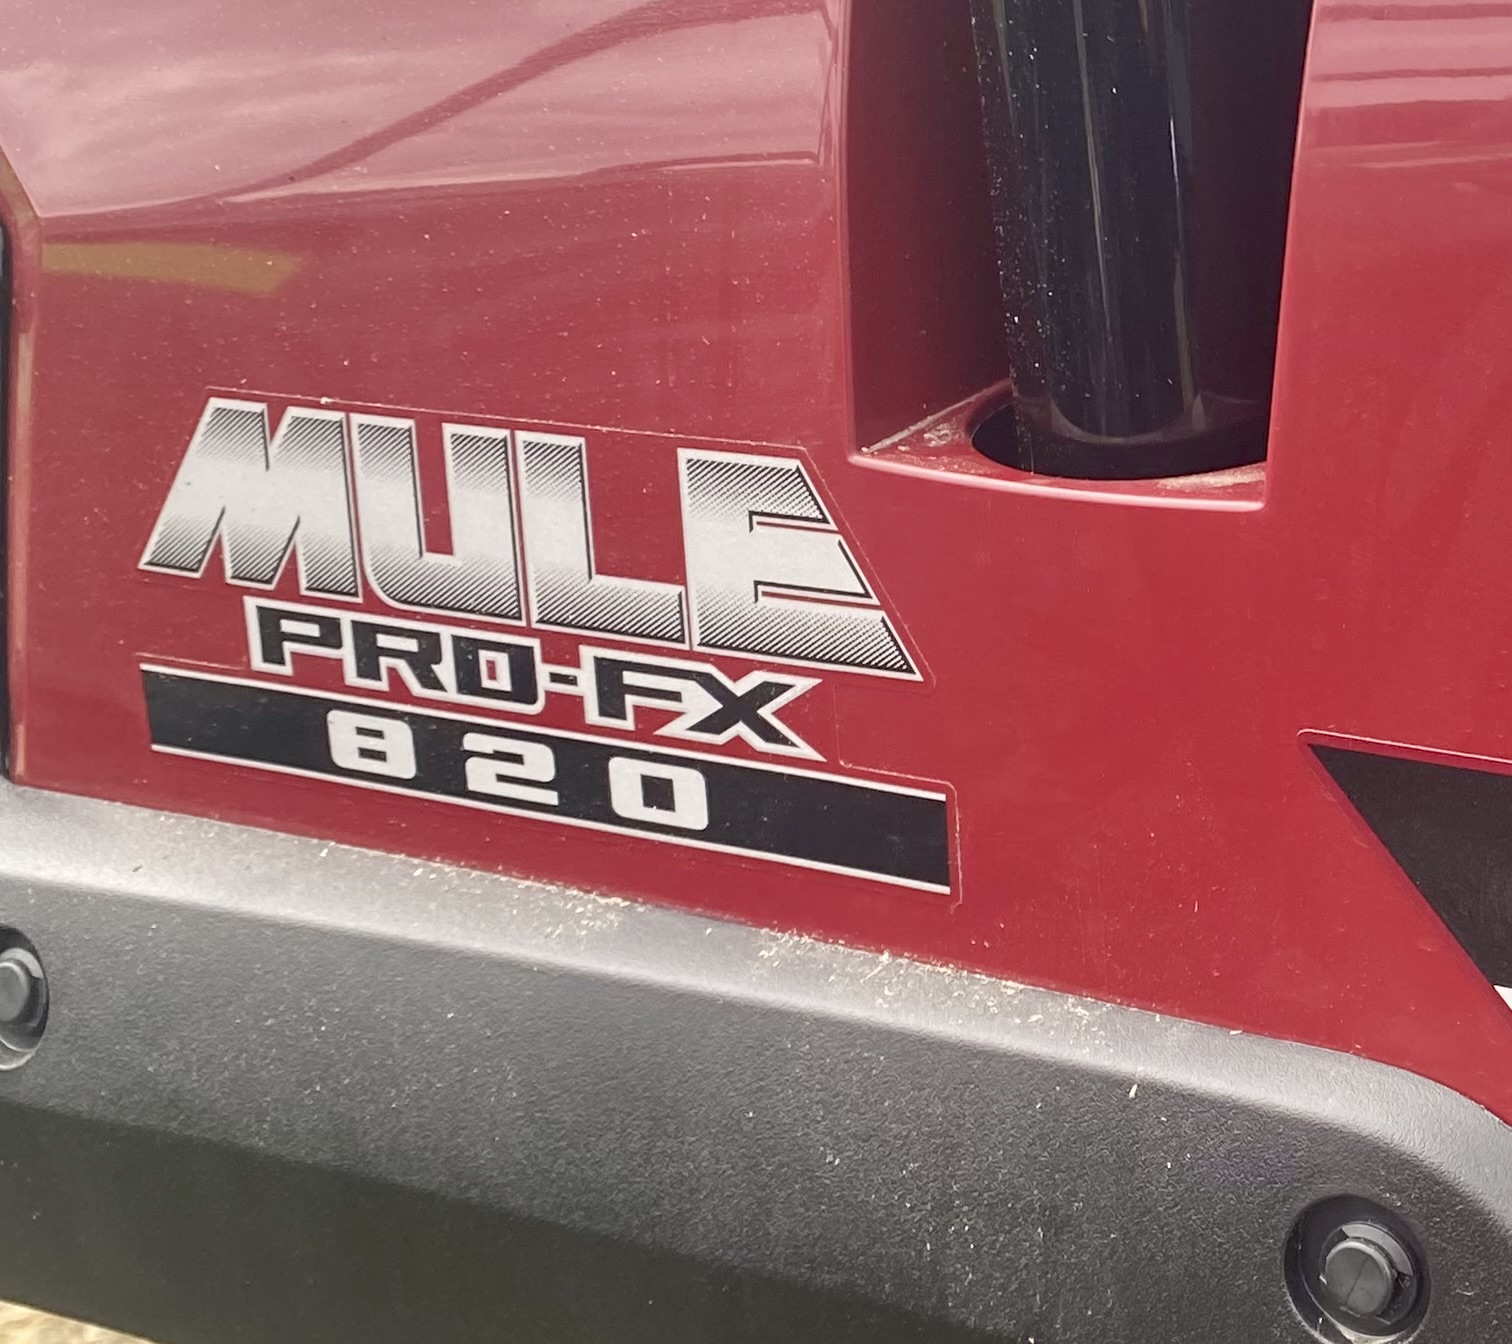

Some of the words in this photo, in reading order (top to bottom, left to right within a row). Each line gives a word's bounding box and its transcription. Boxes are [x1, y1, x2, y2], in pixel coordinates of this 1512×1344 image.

[137, 396, 922, 682] MULE
[243, 596, 827, 762] PRO-FX
[326, 708, 709, 832] 820
